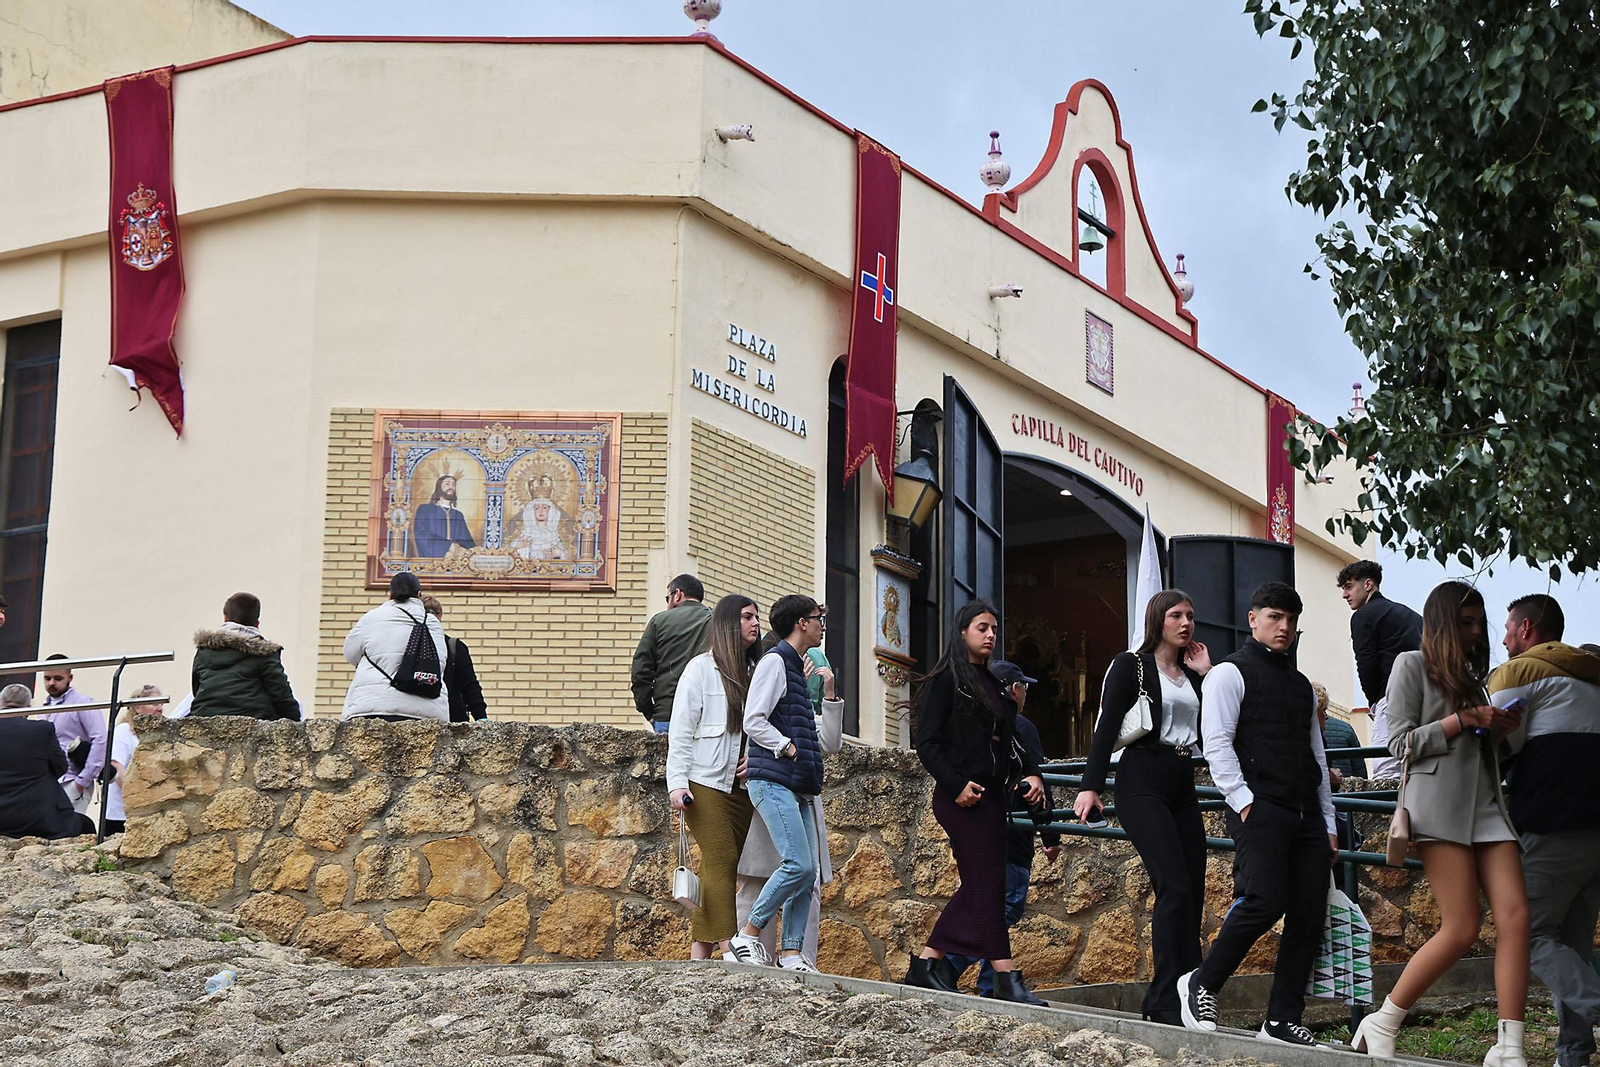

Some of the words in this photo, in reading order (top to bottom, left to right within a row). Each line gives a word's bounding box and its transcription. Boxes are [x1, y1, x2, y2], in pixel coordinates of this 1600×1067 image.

[729, 323, 777, 362] PLAZA
[728, 354, 747, 378] DE
[756, 368, 776, 392] LA
[691, 368, 807, 437] MISERICORDIA
[1011, 413, 1065, 448] CAPILLA
[1068, 432, 1091, 462] DEL
[1094, 447, 1144, 497] CAUTIVO
